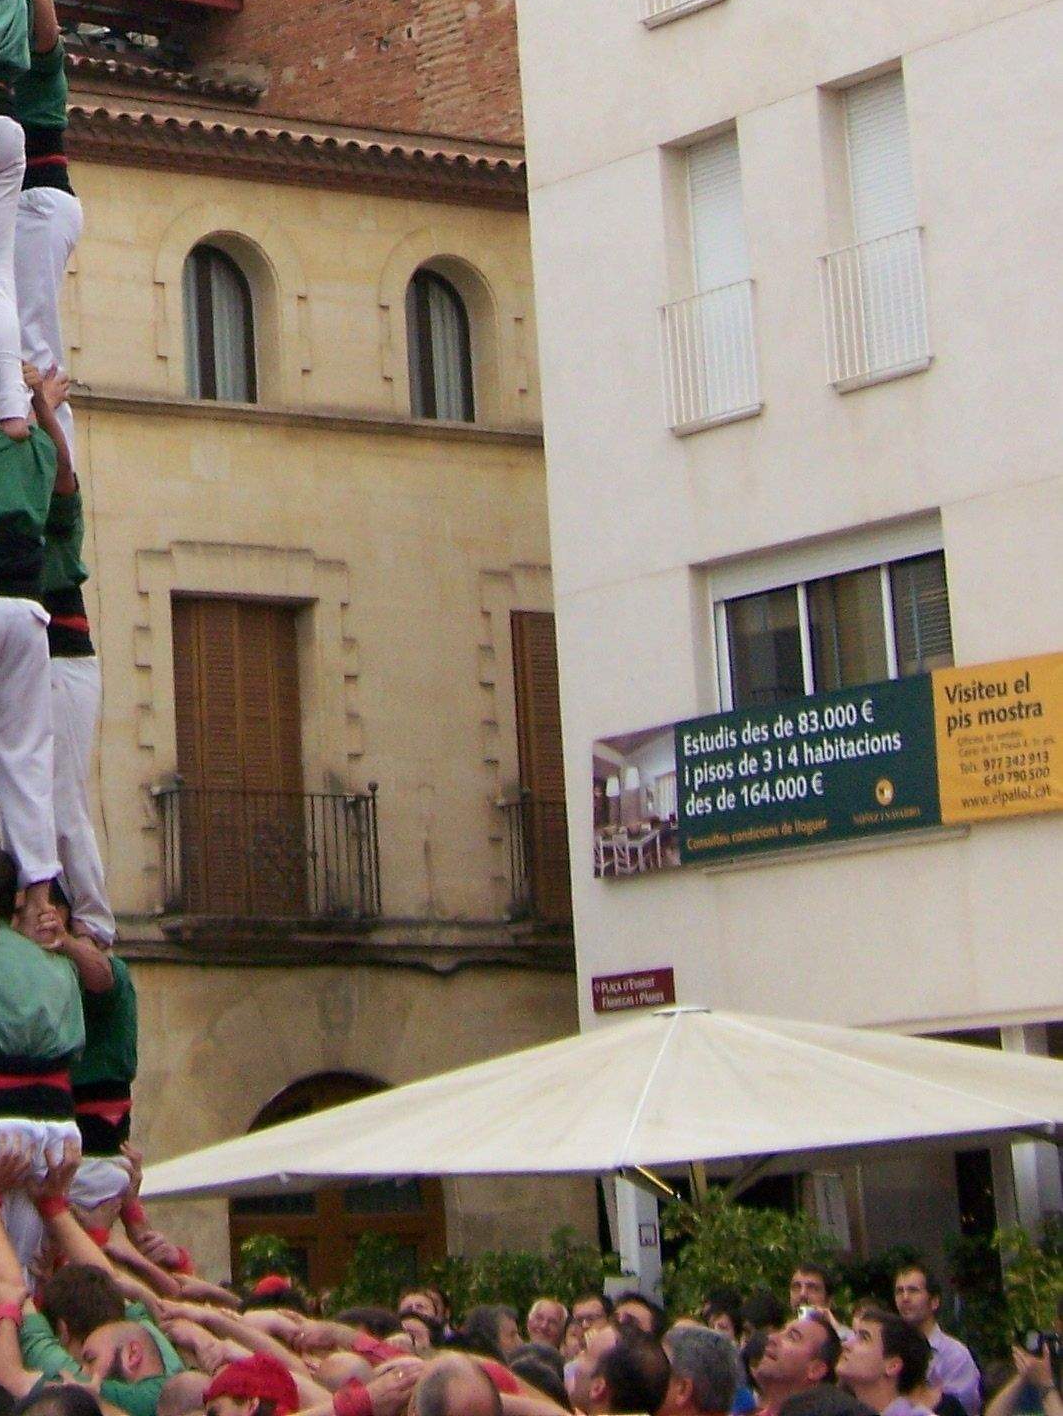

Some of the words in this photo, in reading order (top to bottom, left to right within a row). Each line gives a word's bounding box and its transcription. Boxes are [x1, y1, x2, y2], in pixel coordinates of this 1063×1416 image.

[944, 680, 1008, 704] Visiteu
[1013, 671, 1030, 694] el
[683, 726, 737, 756] Estudis
[741, 720, 769, 746] des
[773, 714, 794, 739] de
[798, 702, 857, 735] 83.000
[861, 699, 875, 724] €
[946, 707, 972, 737] pis
[978, 700, 1043, 725] mostra
[684, 765, 690, 787] i
[693, 759, 734, 792] pisos
[738, 752, 758, 777] de
[762, 750, 773, 773] 3
[777, 746, 783, 770] i
[788, 744, 799, 768] 4
[803, 731, 902, 766] habitacions
[685, 793, 712, 817] des
[716, 787, 736, 811] de
[740, 774, 807, 808] 164.000
[811, 771, 825, 796] €
